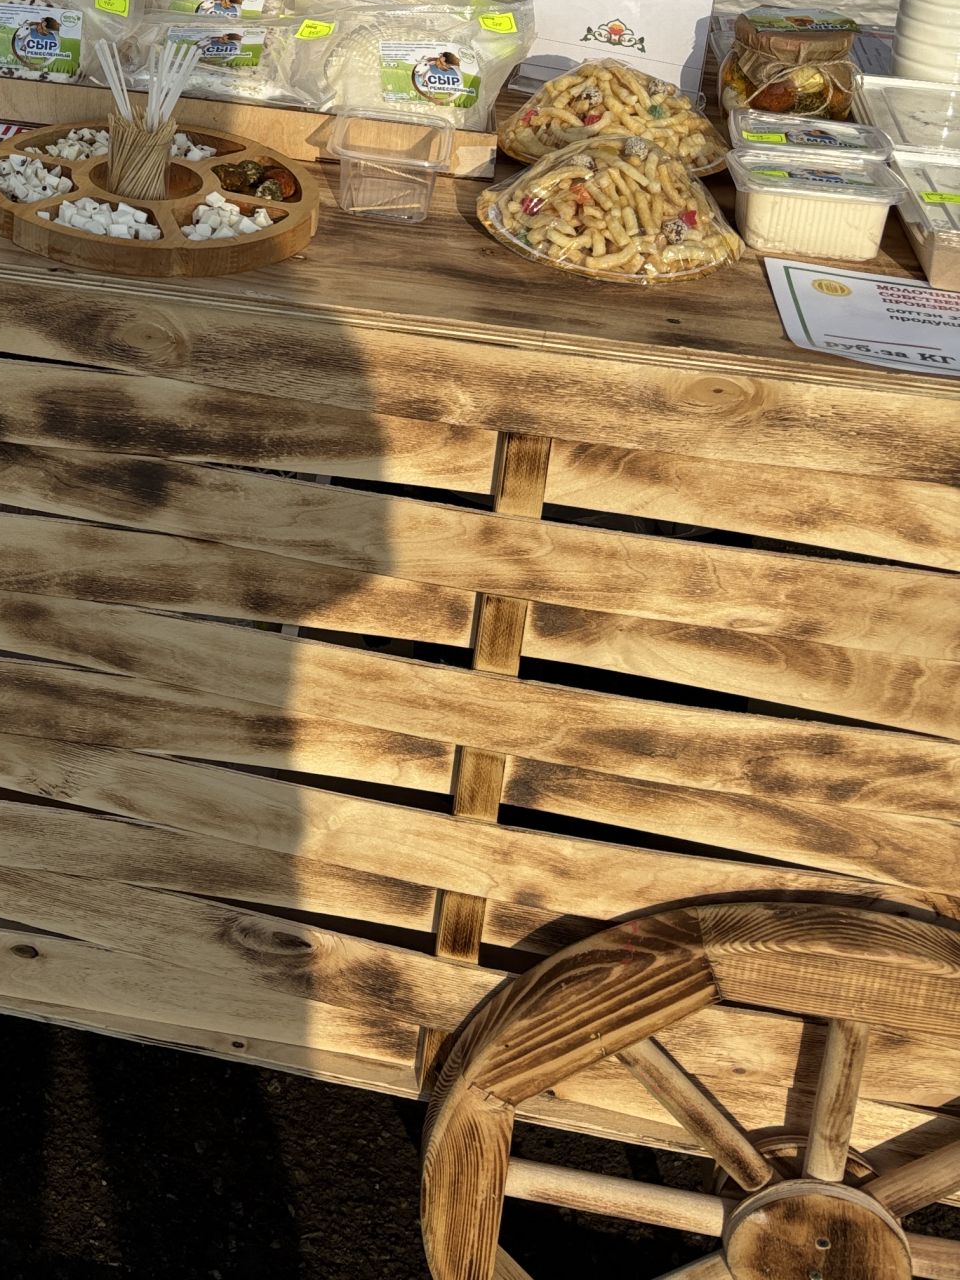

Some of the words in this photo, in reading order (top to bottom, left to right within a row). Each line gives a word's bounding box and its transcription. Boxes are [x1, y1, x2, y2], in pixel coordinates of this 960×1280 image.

[26, 39, 58, 51] СЫР
[206, 45, 238, 53] СЫР
[427, 75, 460, 86] СЫР
